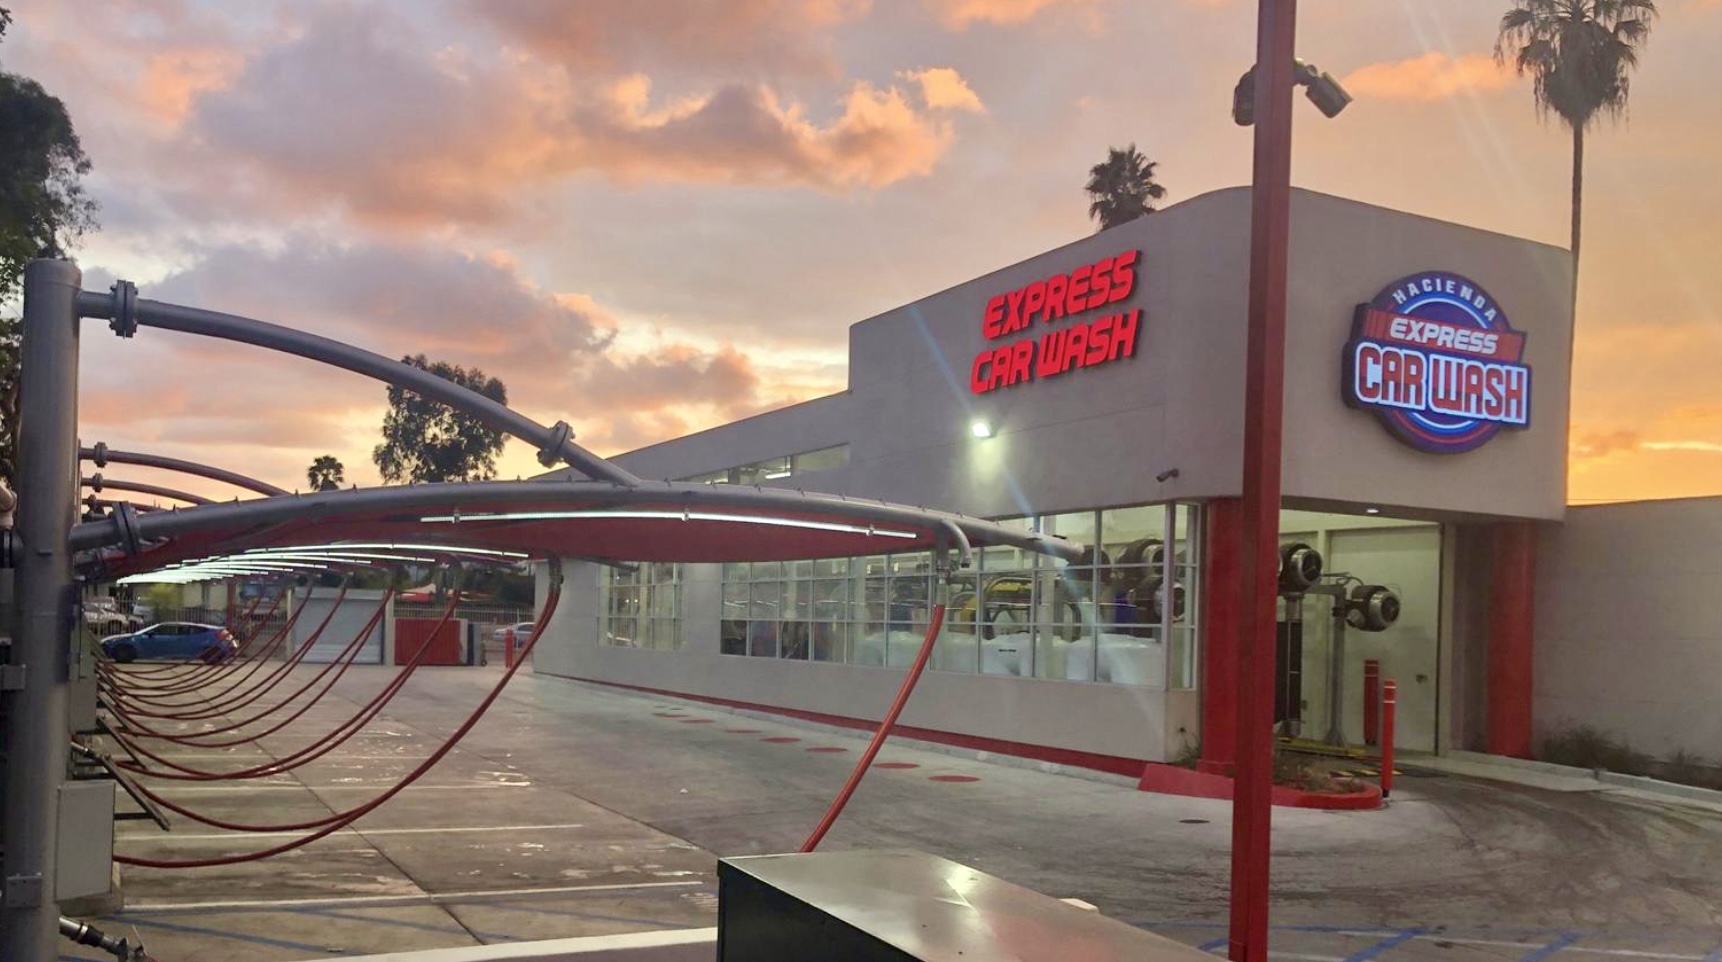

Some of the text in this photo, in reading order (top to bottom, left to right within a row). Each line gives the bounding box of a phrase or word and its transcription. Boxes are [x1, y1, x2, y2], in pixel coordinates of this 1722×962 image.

[983, 249, 1138, 340] EXPRESS
[1390, 317, 1498, 355] EXPRESS
[1392, 278, 1497, 322] HACIENDA
[970, 309, 1139, 394] CAR WASH
[1355, 341, 1528, 424] CAR WASH
